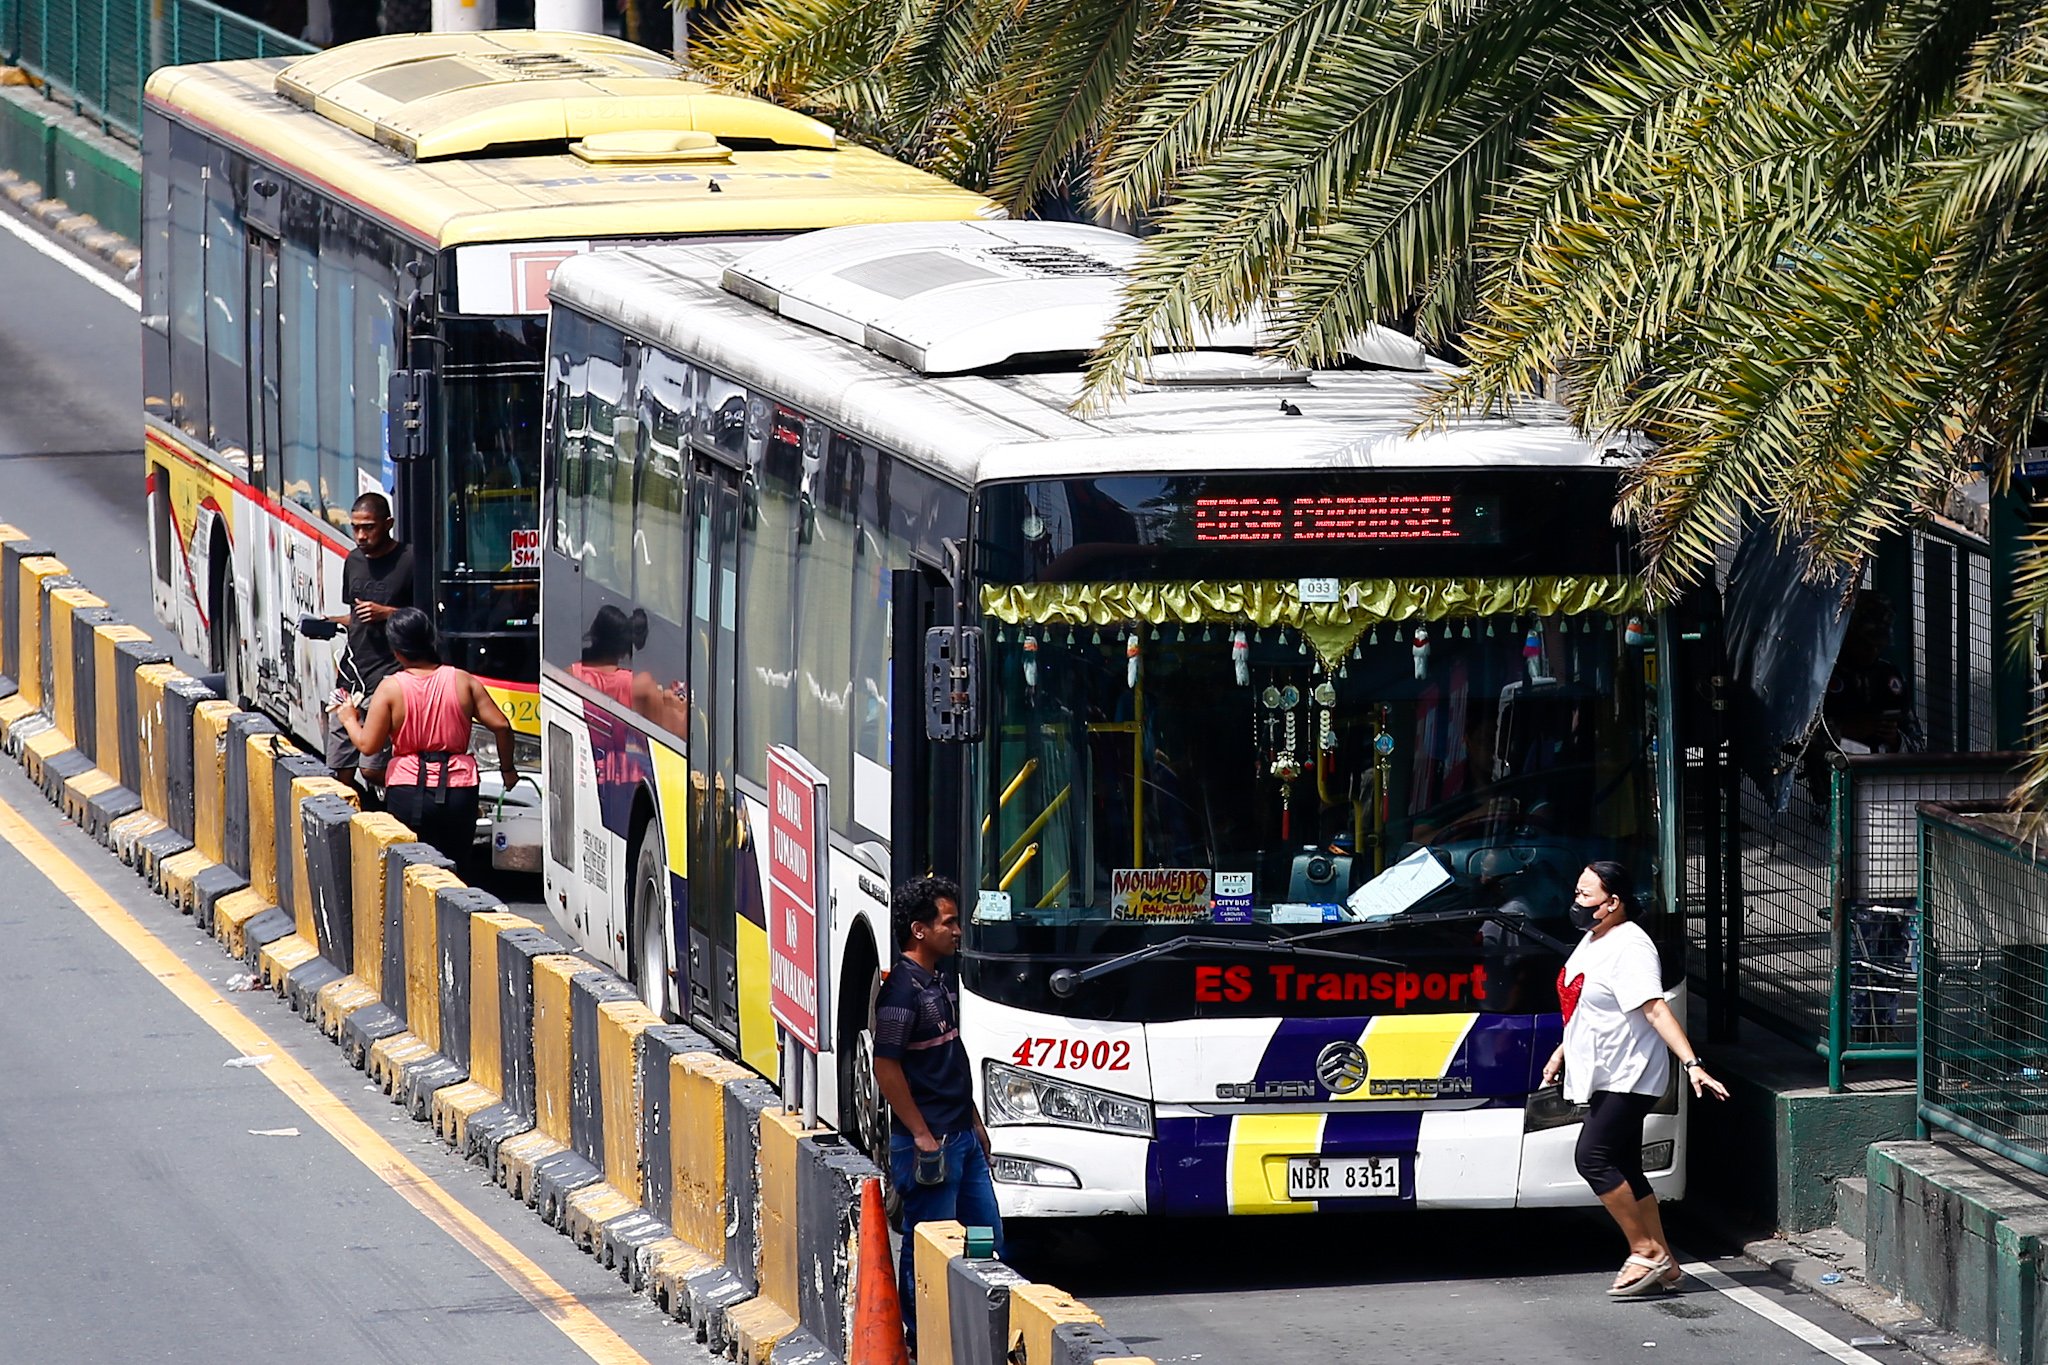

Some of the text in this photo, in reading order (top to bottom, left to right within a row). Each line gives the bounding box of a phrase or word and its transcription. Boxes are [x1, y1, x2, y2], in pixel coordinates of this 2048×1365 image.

[1196, 495, 1460, 541] EDSA CAROUSEL
[1307, 582, 1330, 593] 033
[776, 779, 803, 832] BAWAL
[773, 824, 808, 883] TUMAWID
[1113, 870, 1208, 897] MONUMENTO
[1140, 891, 1196, 904] MCU
[1216, 899, 1250, 907] CITY BUS
[771, 947, 815, 1017] JAYWALKING
[1195, 963, 1488, 1008] ES Transport
[1012, 1037, 1131, 1071] 471902
[1215, 1076, 1472, 1099] GOLDEN DRAGON
[1292, 1166, 1397, 1189] NBR 8351
